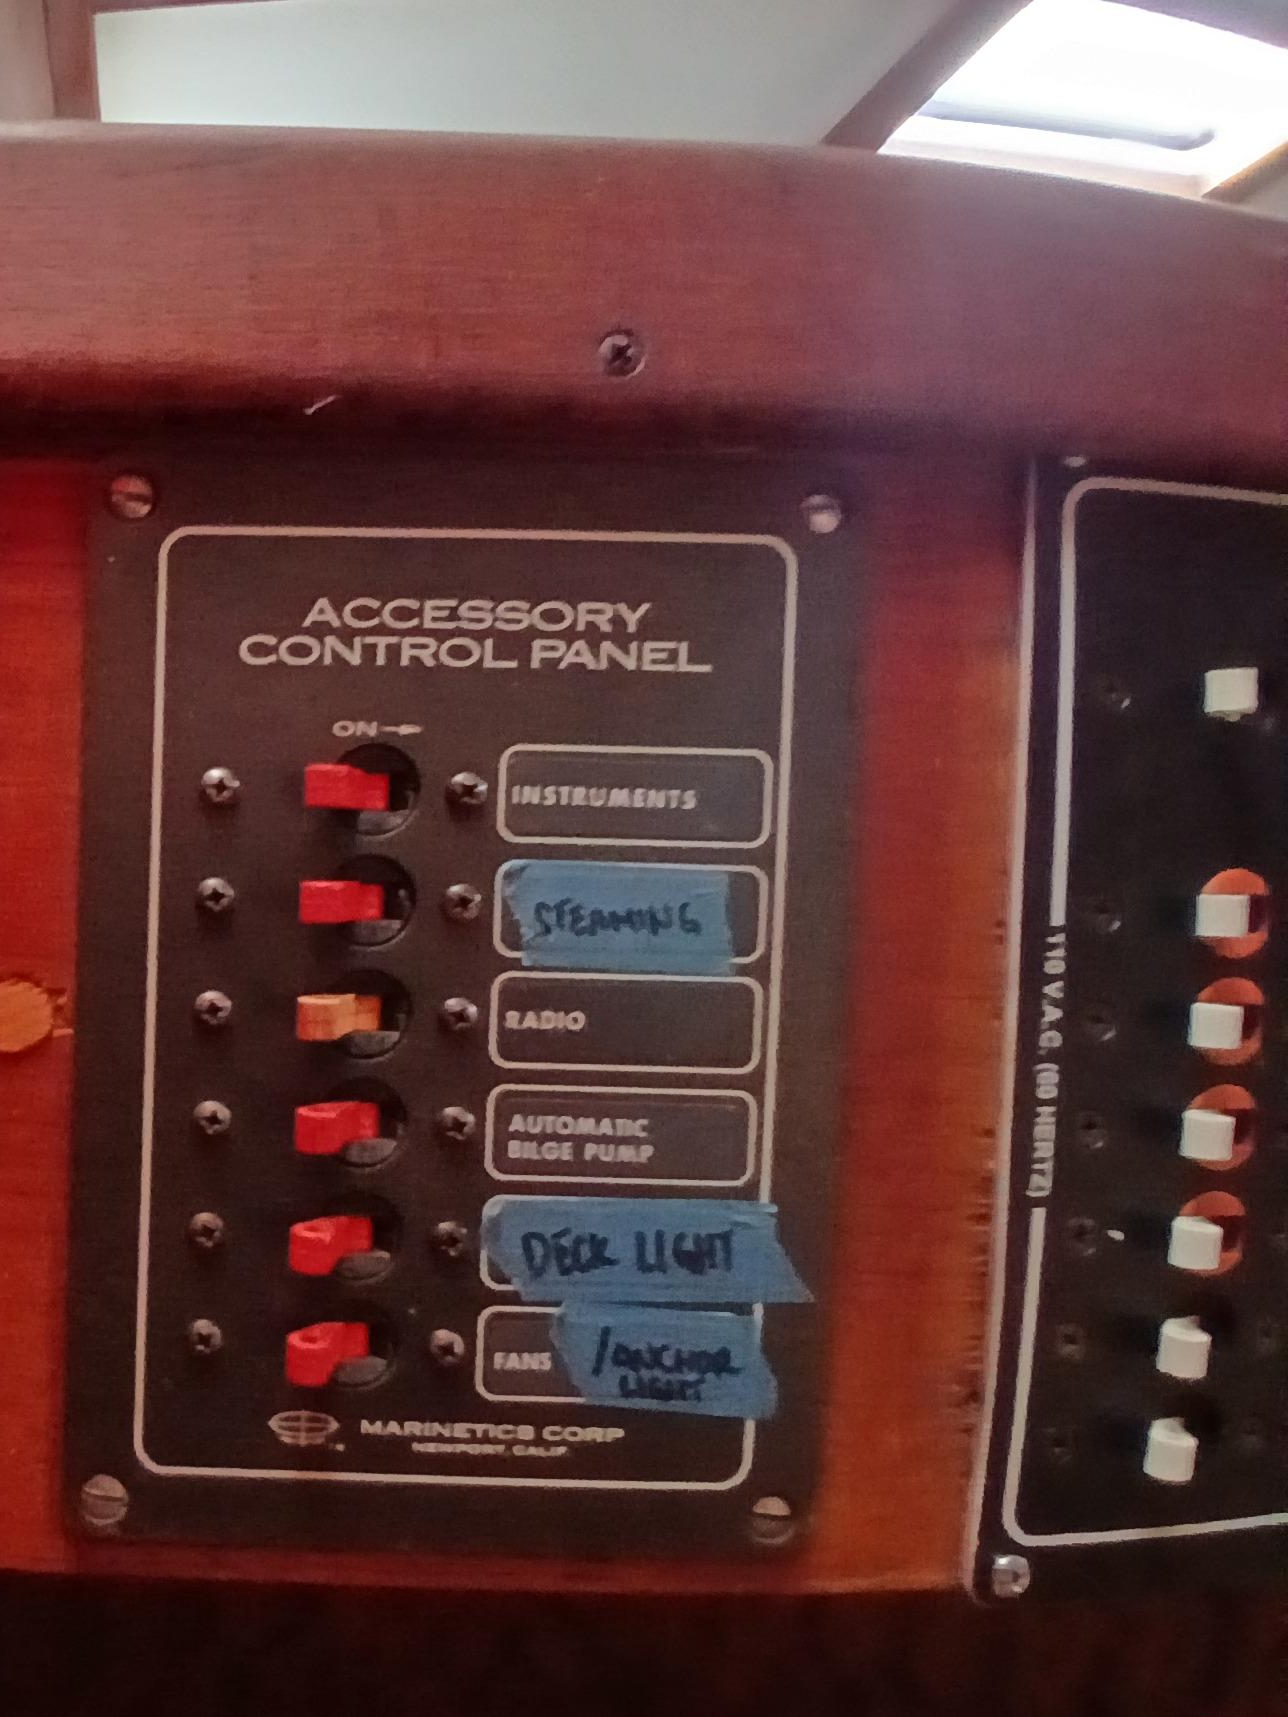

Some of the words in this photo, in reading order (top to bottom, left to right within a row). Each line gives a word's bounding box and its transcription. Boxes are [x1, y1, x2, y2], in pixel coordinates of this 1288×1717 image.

[302, 597, 651, 633] ACCESSORY
[238, 634, 518, 669] CONTROL
[529, 638, 713, 673] PANEL
[332, 720, 378, 737] ON
[512, 784, 697, 810] INSTRUMENTS
[1043, 933, 1066, 974] 110
[505, 1011, 587, 1031] RADIO
[509, 1114, 649, 1137] AUTOMATIC
[507, 1140, 574, 1161] BILGE
[584, 1143, 655, 1163] PUMP
[521, 1227, 619, 1278] DECK
[634, 1228, 734, 1275] LIGHT
[493, 1352, 552, 1371] FANS
[360, 1419, 535, 1440] MARINETICS
[542, 1424, 625, 1442] CORP
